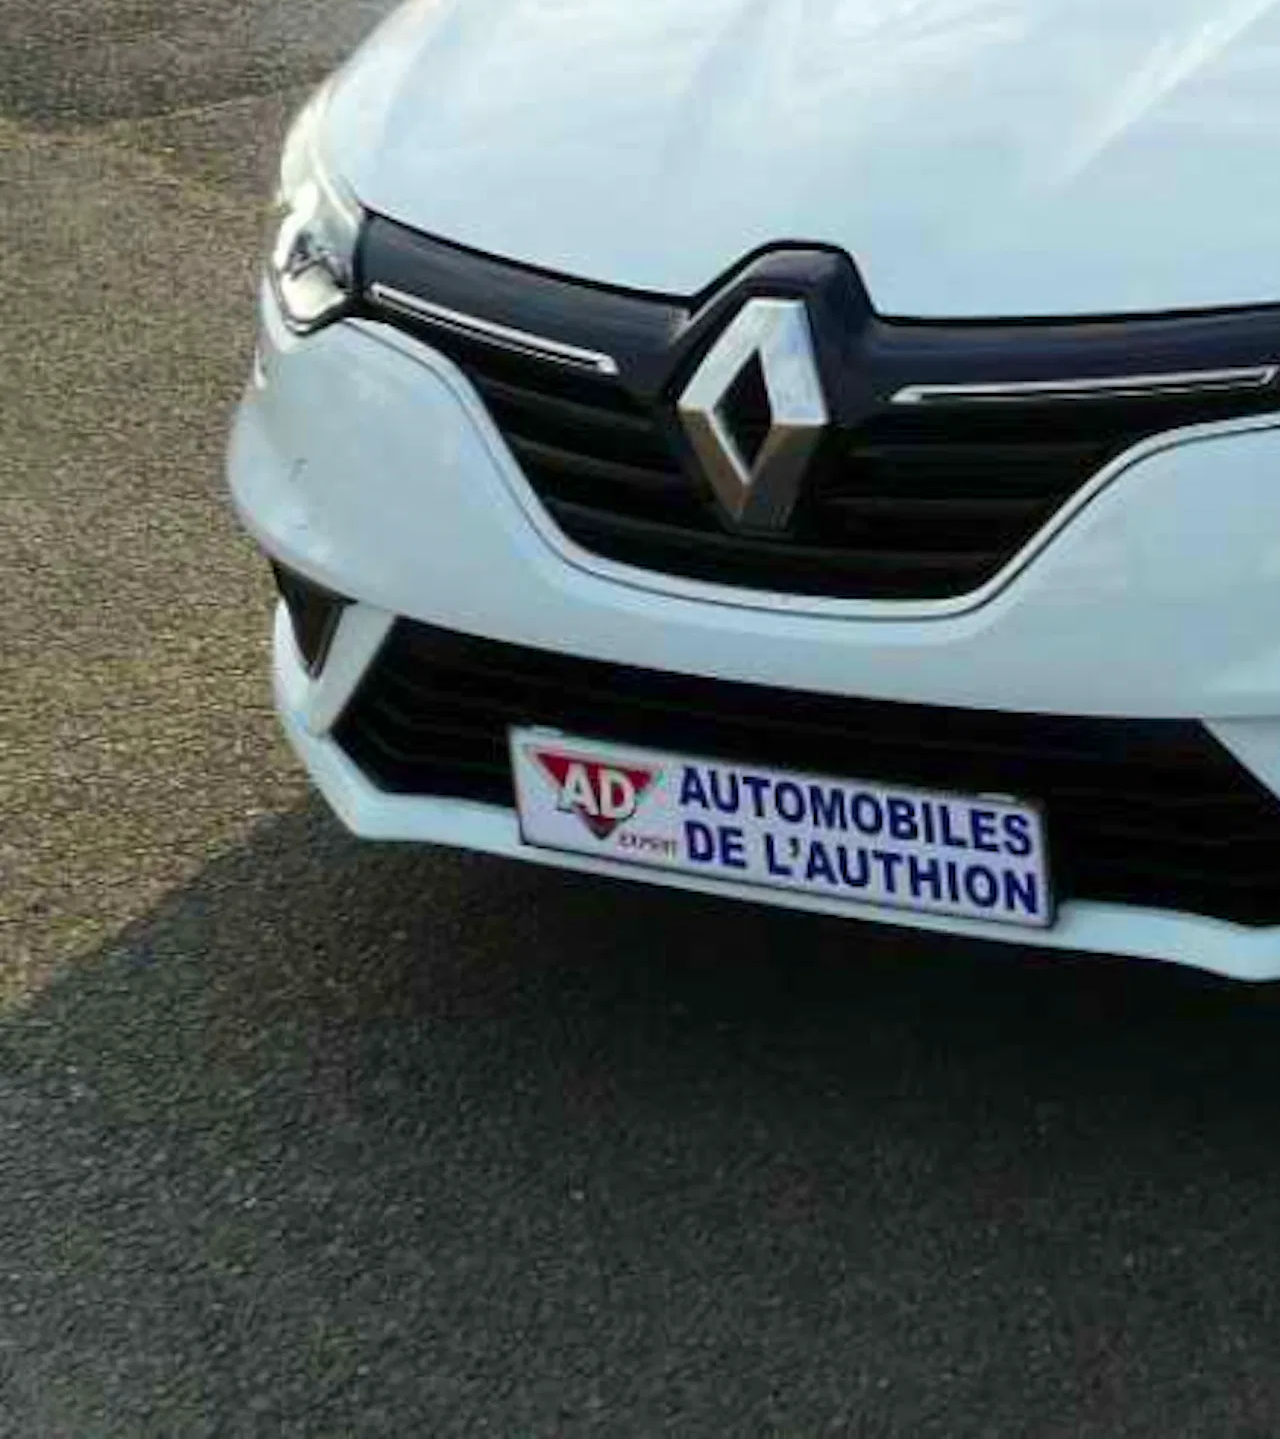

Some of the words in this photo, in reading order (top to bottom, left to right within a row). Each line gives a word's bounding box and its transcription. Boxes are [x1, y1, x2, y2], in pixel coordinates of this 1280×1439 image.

[556, 760, 637, 820] AD
[678, 766, 1032, 857] AUTOMOBILES
[684, 819, 749, 870] DE
[765, 831, 1039, 915] L'AUTHION
